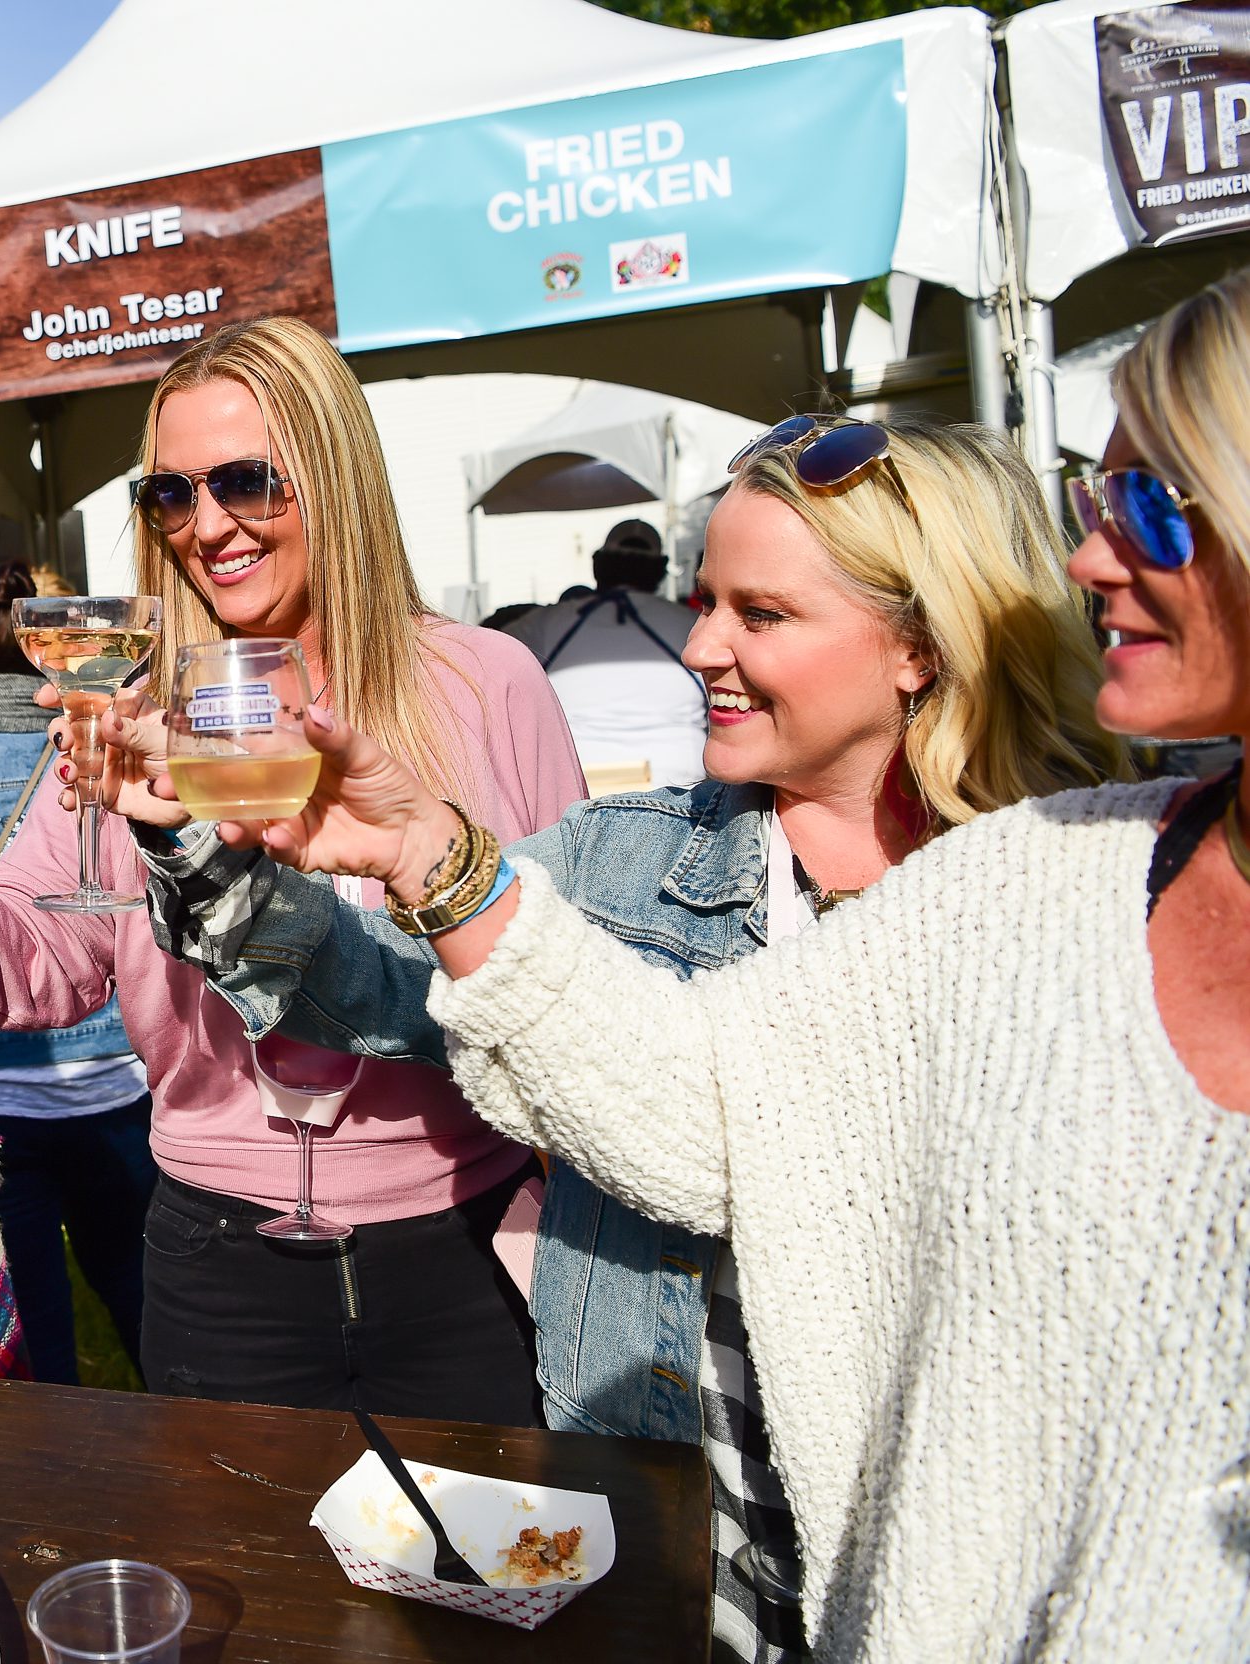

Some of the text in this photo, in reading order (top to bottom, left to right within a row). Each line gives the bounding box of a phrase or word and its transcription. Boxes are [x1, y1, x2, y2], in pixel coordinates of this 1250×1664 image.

[1166, 44, 1219, 58] FARMERS
[524, 119, 684, 182] FRIED
[1120, 83, 1250, 182] VIP
[487, 156, 732, 233] CHICKEN
[1136, 184, 1183, 209] FRIED
[44, 205, 184, 267] KNIFE
[22, 286, 223, 341] John Tesar
[46, 322, 204, 361] @chefjohntesar
[198, 714, 270, 728] SHOWROOM
